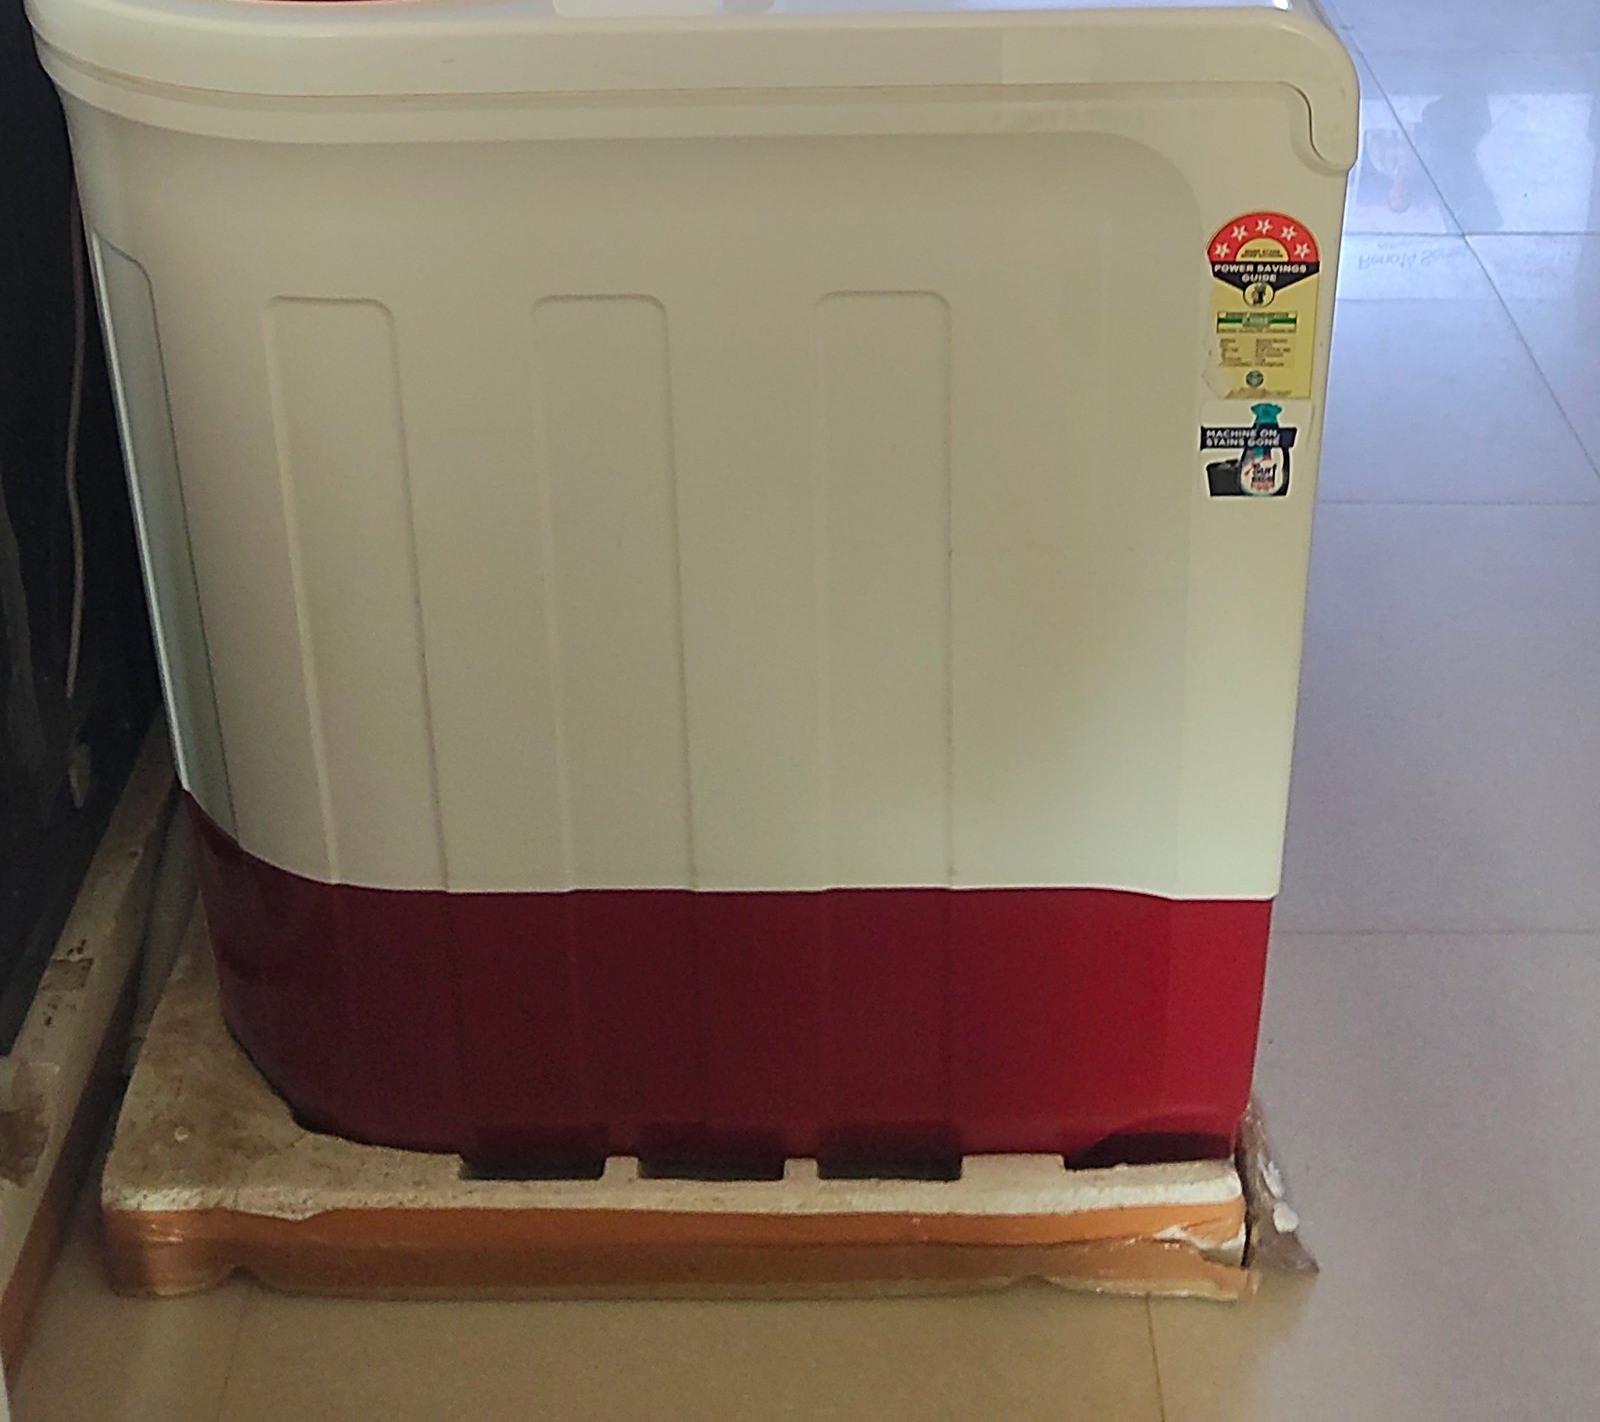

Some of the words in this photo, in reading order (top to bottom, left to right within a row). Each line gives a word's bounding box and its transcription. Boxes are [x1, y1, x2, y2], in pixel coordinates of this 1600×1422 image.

[1214, 263, 1255, 273] POWER
[1256, 263, 1308, 273] SAVINGS
[1241, 273, 1277, 283] GUIDE
[1206, 429, 1256, 438] MACHINE
[1206, 438, 1245, 447] STAINS
[1247, 438, 1280, 447] GONE
